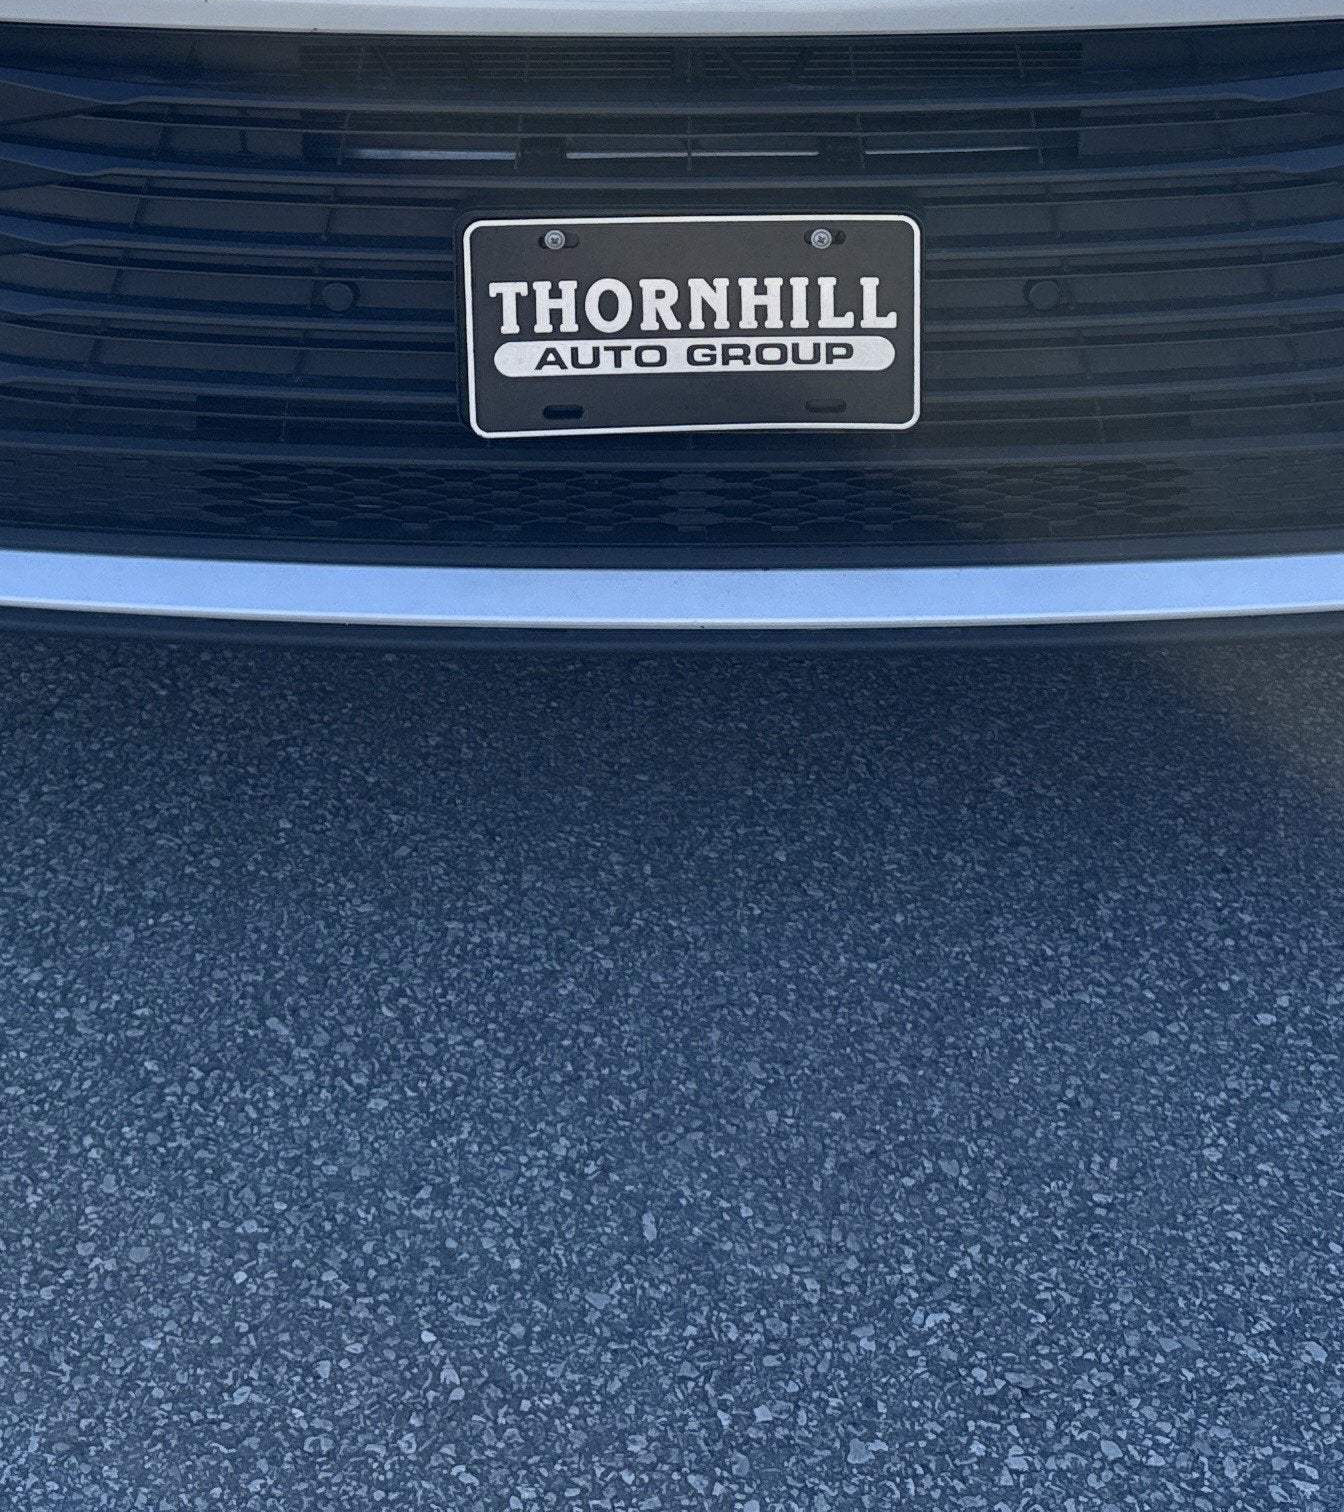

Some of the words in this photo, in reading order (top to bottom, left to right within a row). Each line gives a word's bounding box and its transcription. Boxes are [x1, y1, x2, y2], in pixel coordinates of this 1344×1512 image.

[488, 277, 897, 334] THORNHILL
[535, 343, 668, 371] AUTO
[687, 342, 855, 367] GROUP
